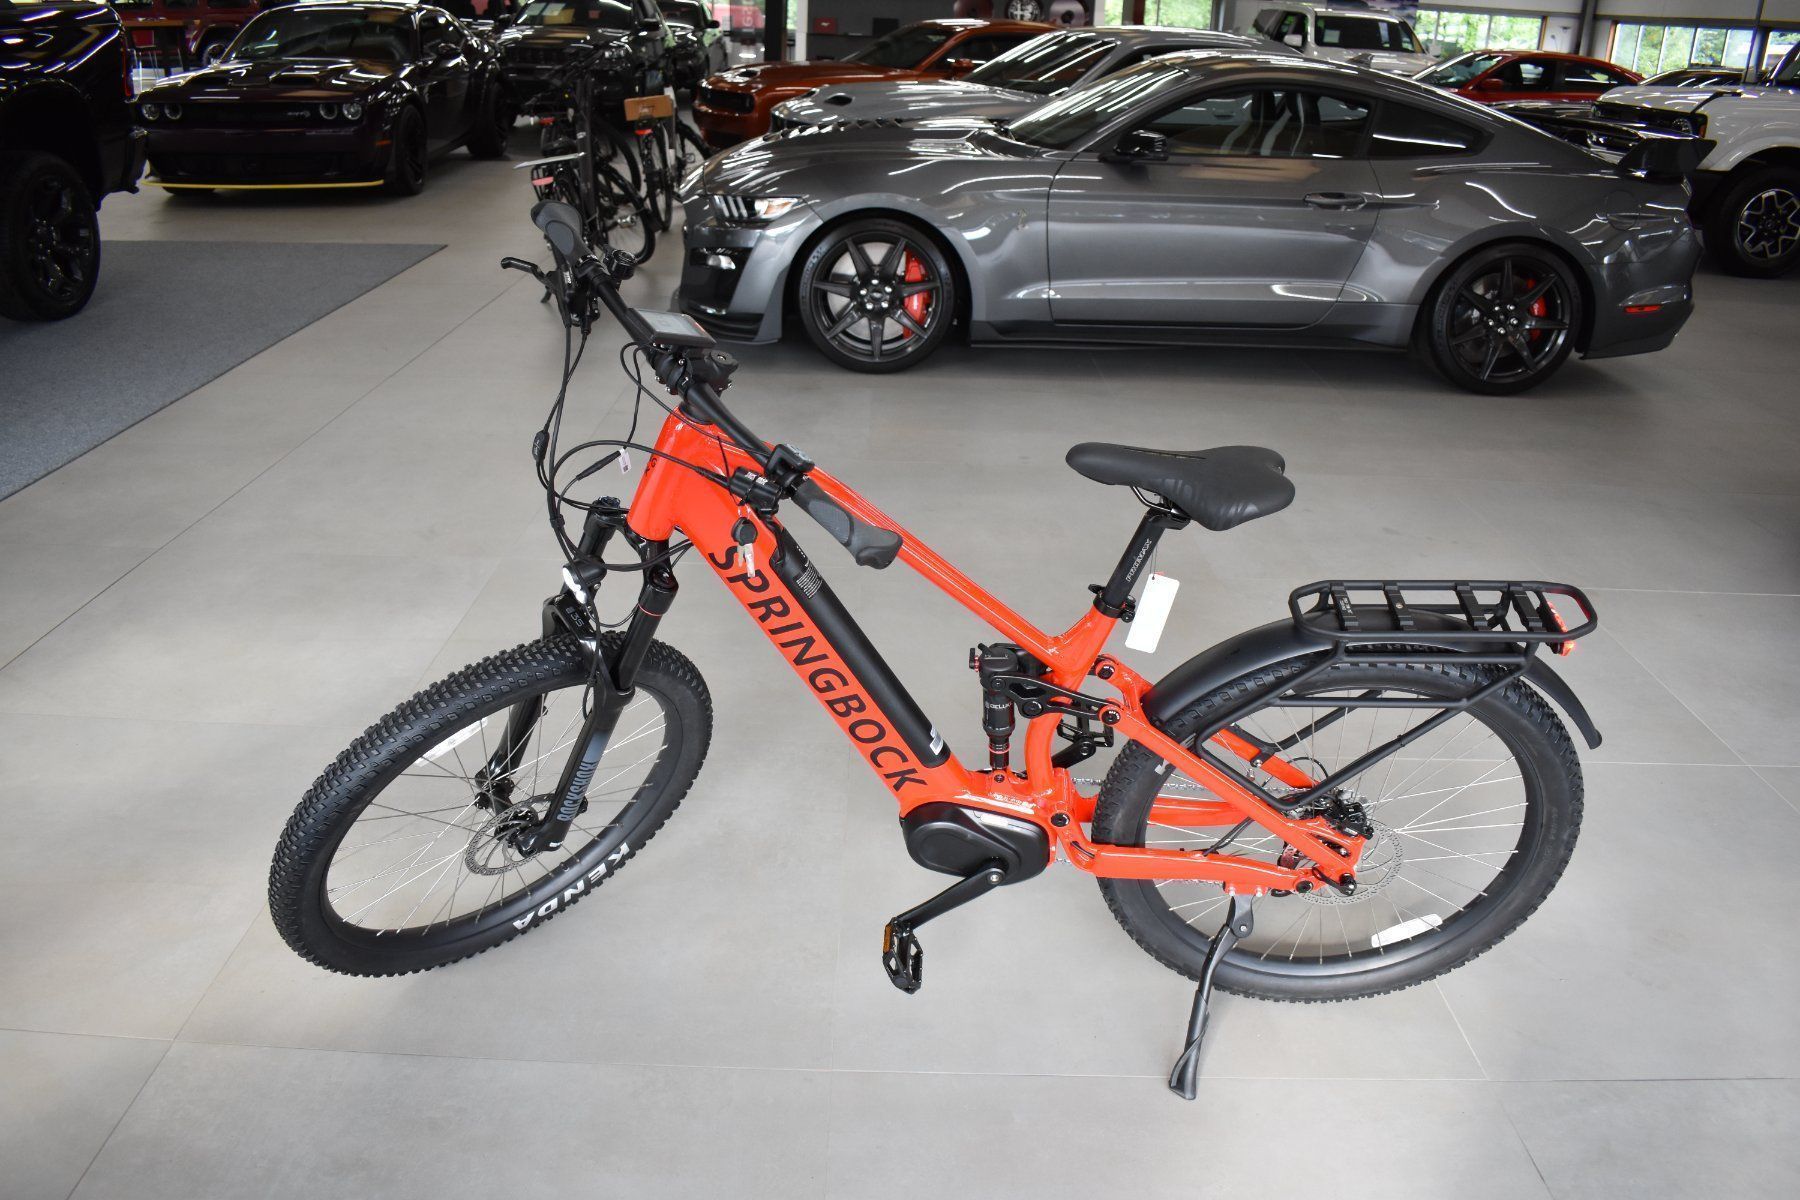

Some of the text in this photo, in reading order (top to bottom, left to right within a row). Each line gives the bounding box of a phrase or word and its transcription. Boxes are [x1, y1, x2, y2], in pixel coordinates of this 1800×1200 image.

[707, 545, 928, 793] SPRINGBOCK
[556, 761, 599, 822] ROCKSHOX
[512, 842, 630, 930] KENDA
